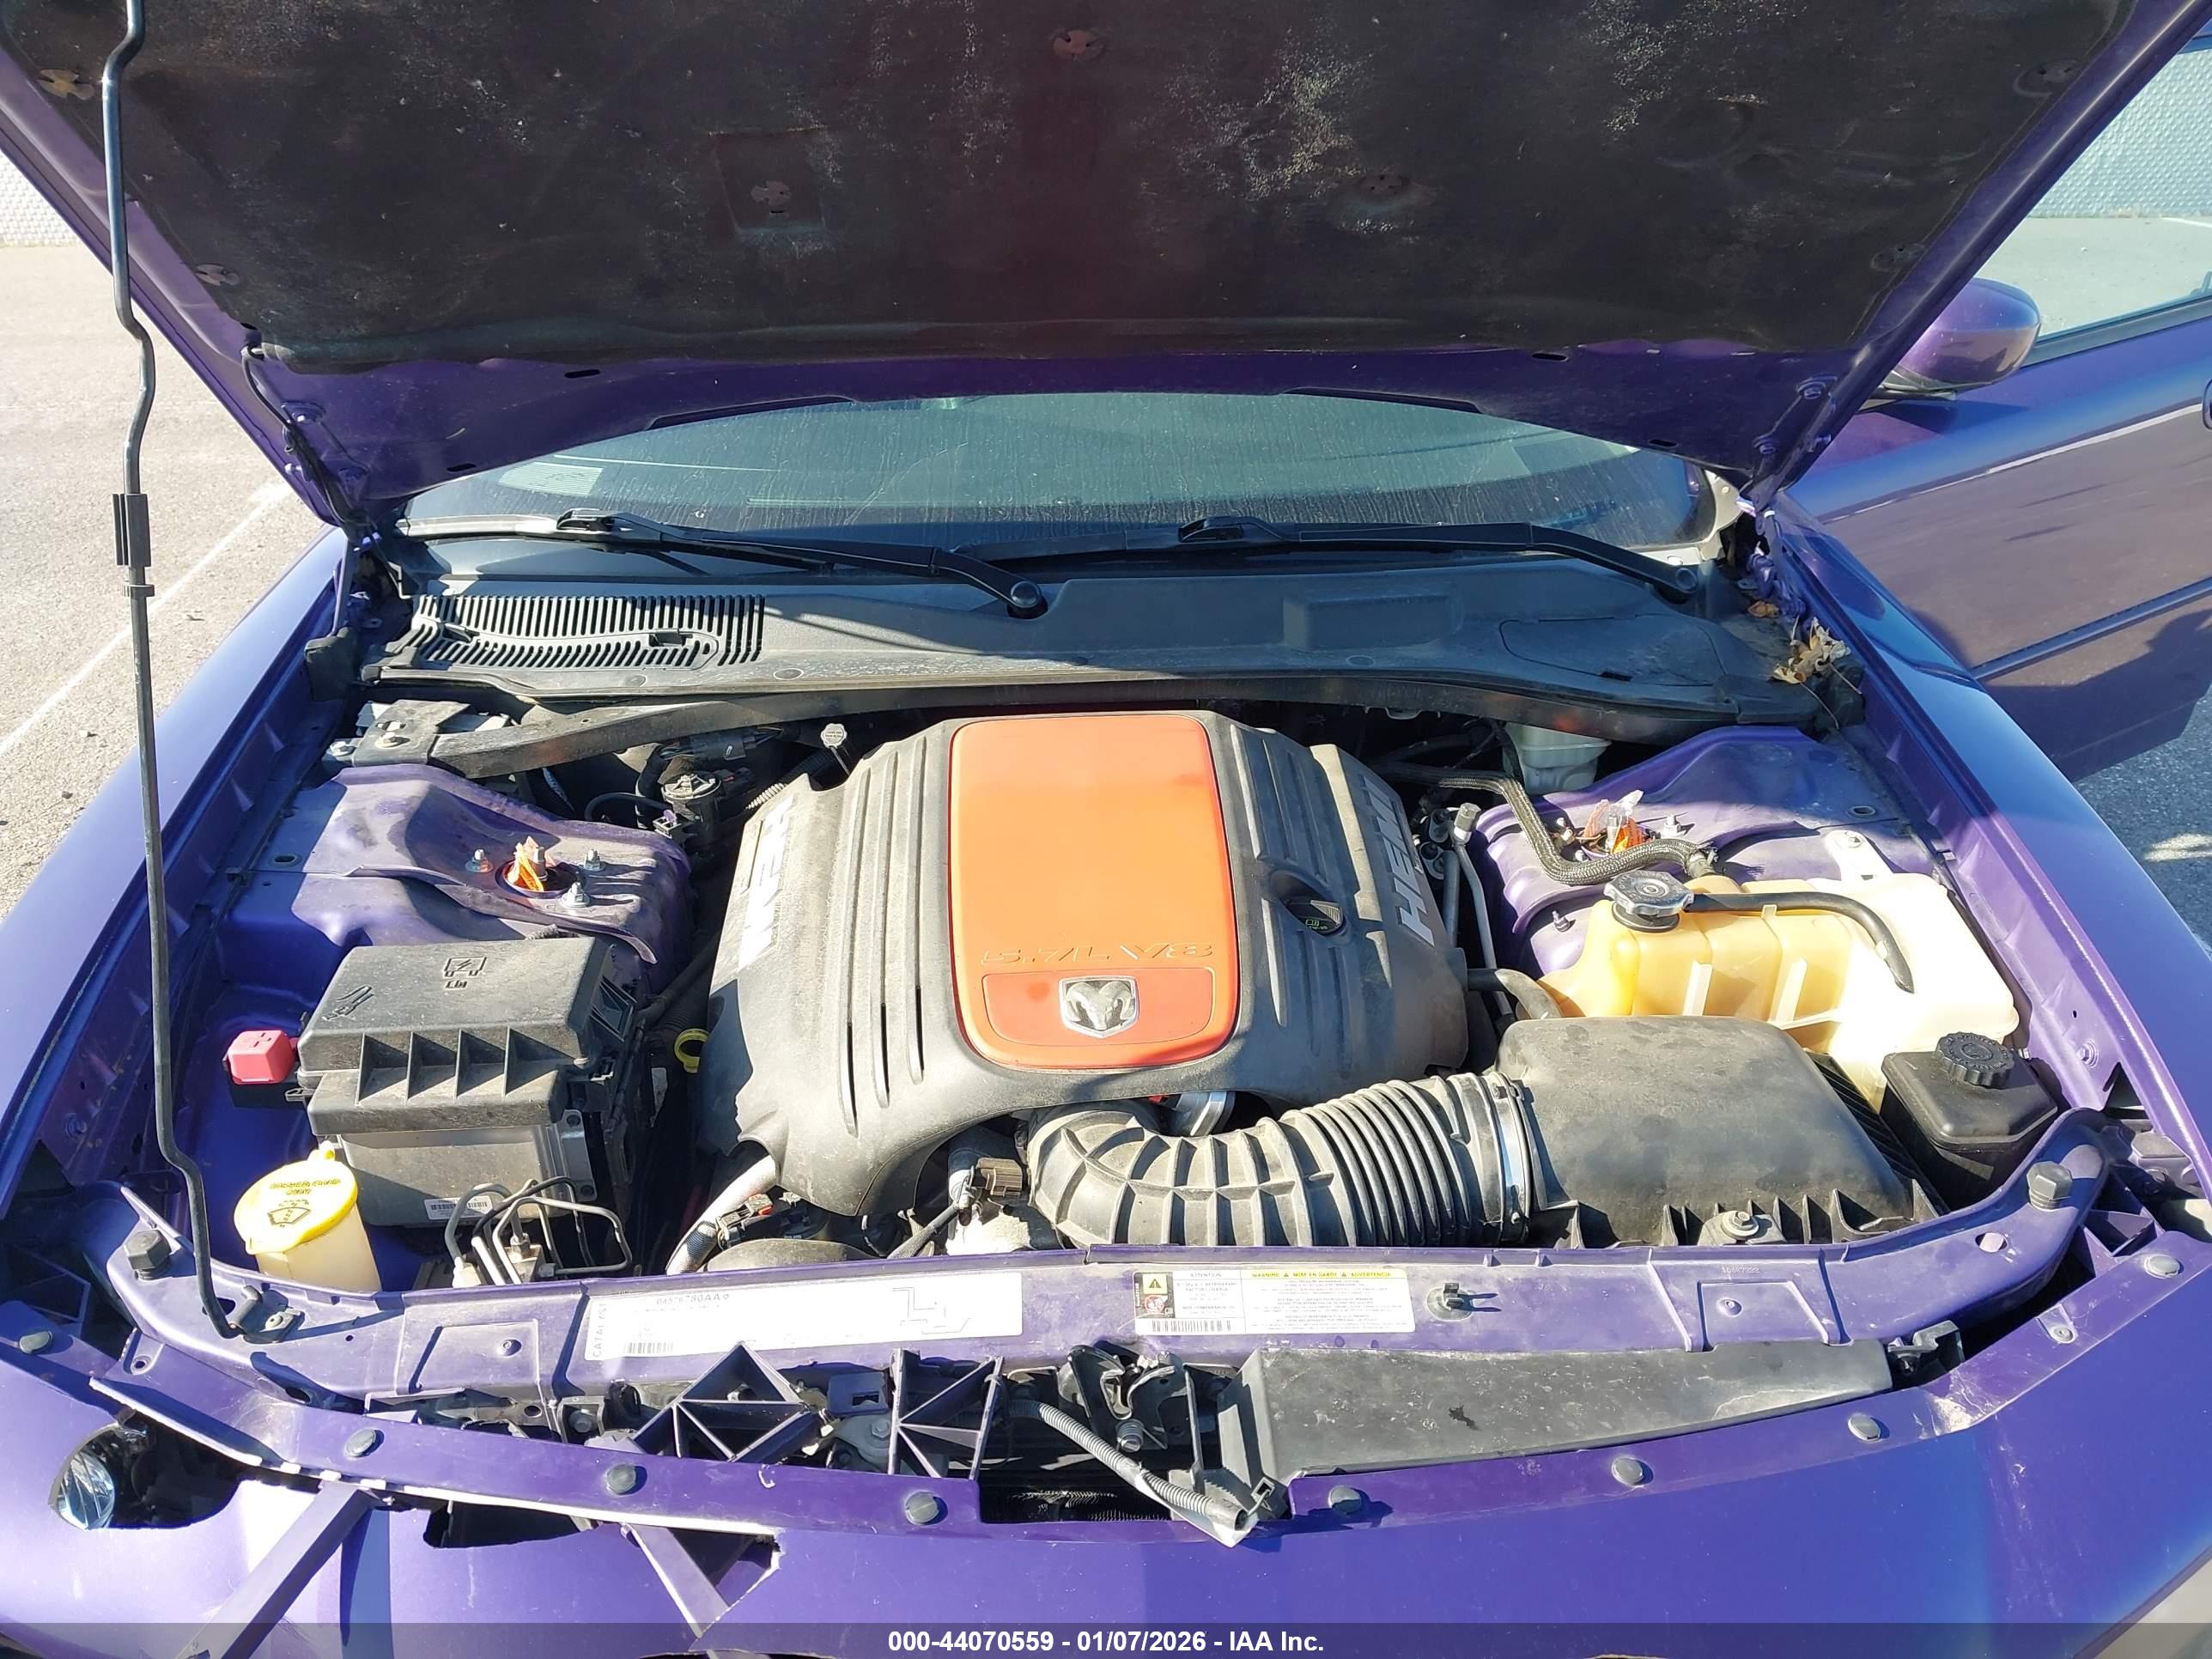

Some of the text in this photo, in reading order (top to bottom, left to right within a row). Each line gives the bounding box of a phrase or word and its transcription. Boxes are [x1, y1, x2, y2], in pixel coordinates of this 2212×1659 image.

[1363, 775, 1435, 947] HEMI
[981, 942, 1213, 966] 5.7L V8
